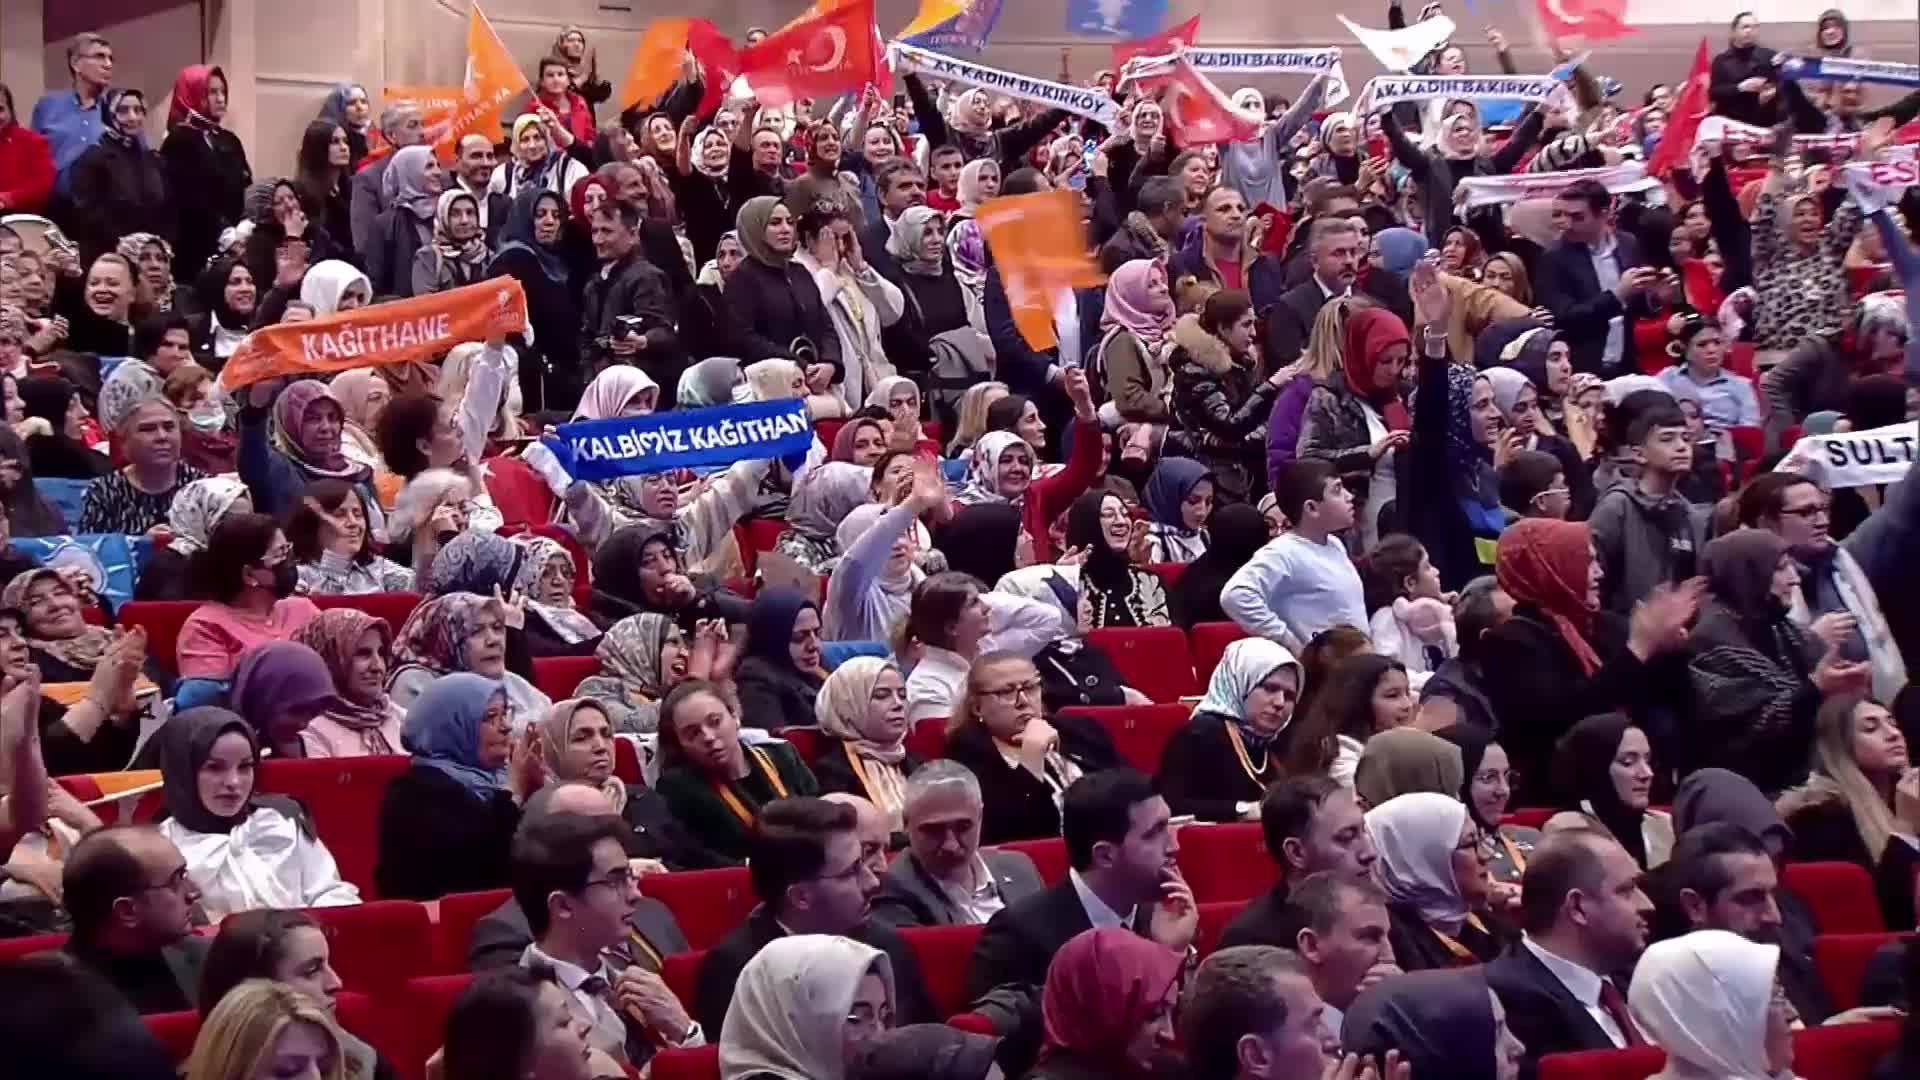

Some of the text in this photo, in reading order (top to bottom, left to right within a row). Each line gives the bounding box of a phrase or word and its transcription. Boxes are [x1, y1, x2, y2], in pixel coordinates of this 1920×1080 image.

[961, 64, 1016, 89] KADIN
[302, 313, 450, 361] KAĞITHANE
[1825, 436, 1914, 468] SULT
